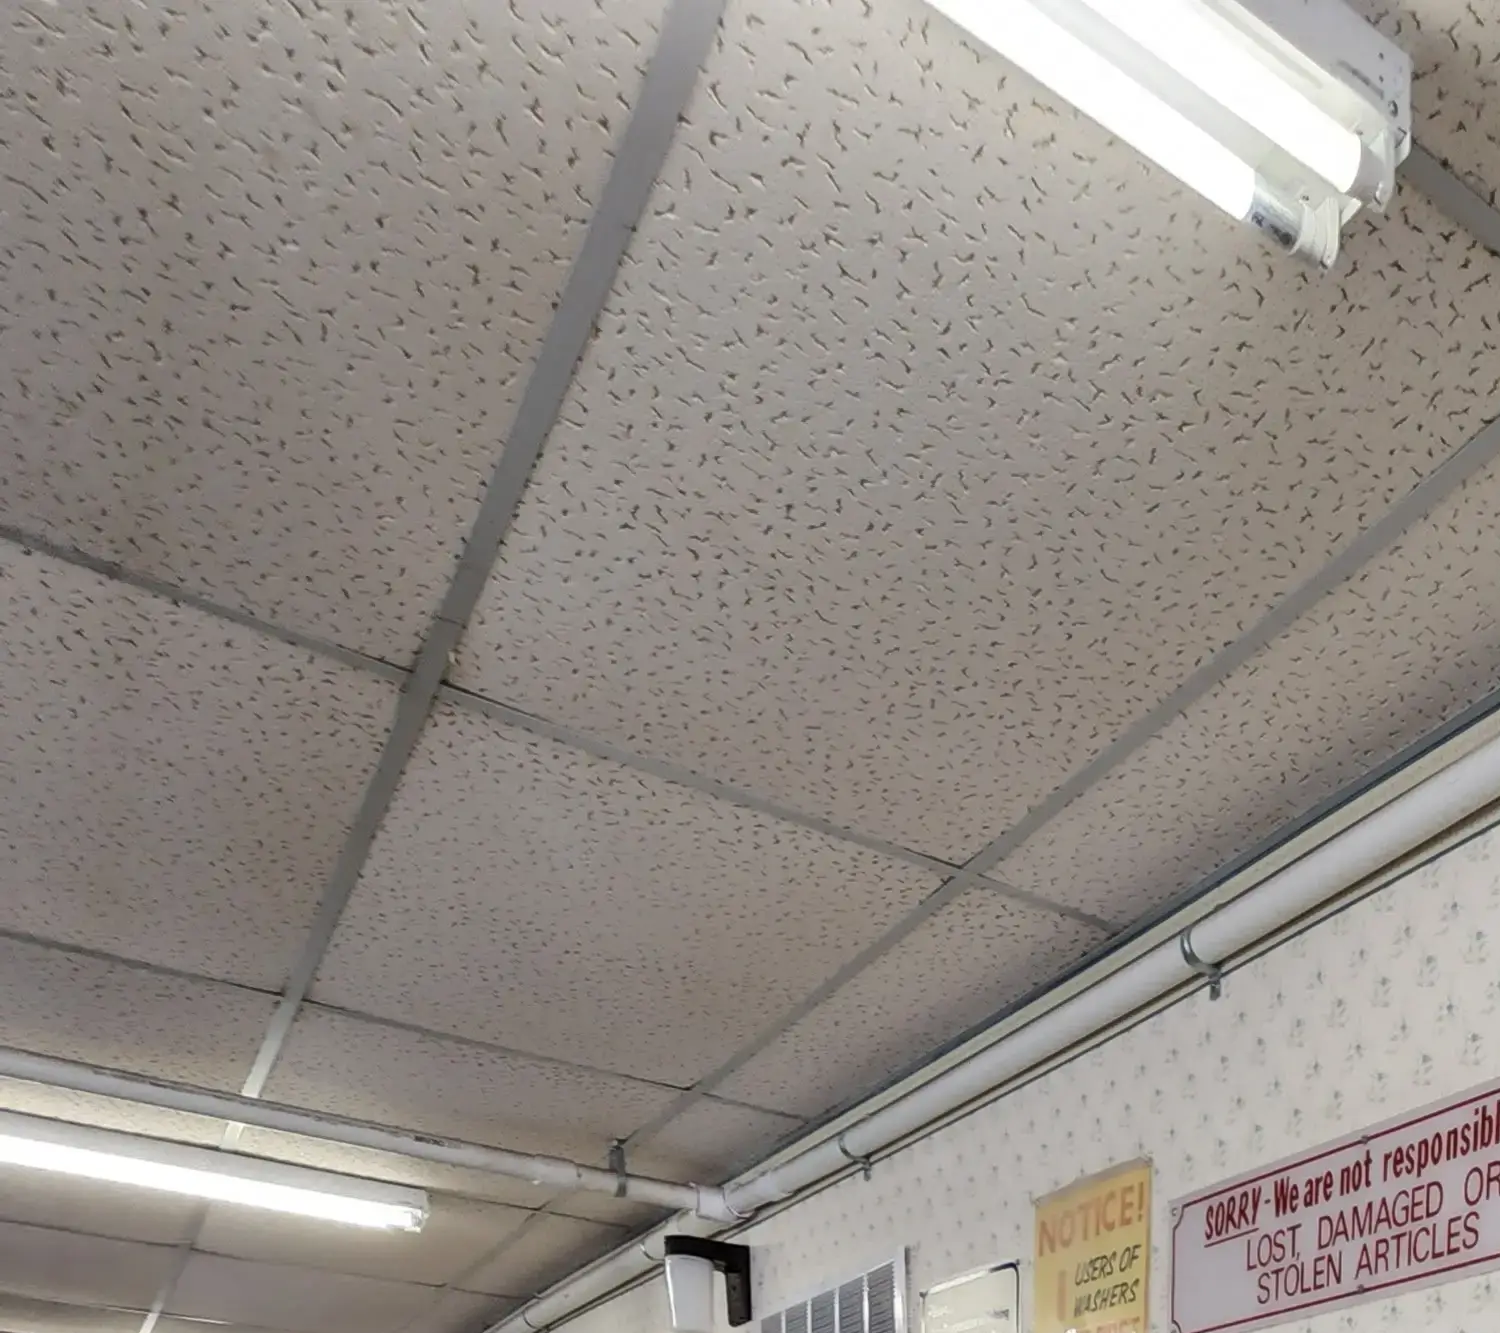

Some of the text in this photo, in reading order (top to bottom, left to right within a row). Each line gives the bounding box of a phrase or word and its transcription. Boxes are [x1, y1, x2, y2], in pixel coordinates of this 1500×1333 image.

[1038, 1182, 1145, 1257] NOTICE!
[1205, 1186, 1262, 1240] SORRY
[1273, 1176, 1299, 1218] We
[1303, 1171, 1334, 1208] are
[1340, 1149, 1373, 1196] not
[1247, 1223, 1302, 1271] LOST,
[1318, 1181, 1443, 1250] DAMAGED
[1074, 1278, 1140, 1317] WASHERS
[1075, 1244, 1142, 1286] USERS OF
[1257, 1211, 1480, 1305] STOLEN ARTICLES
